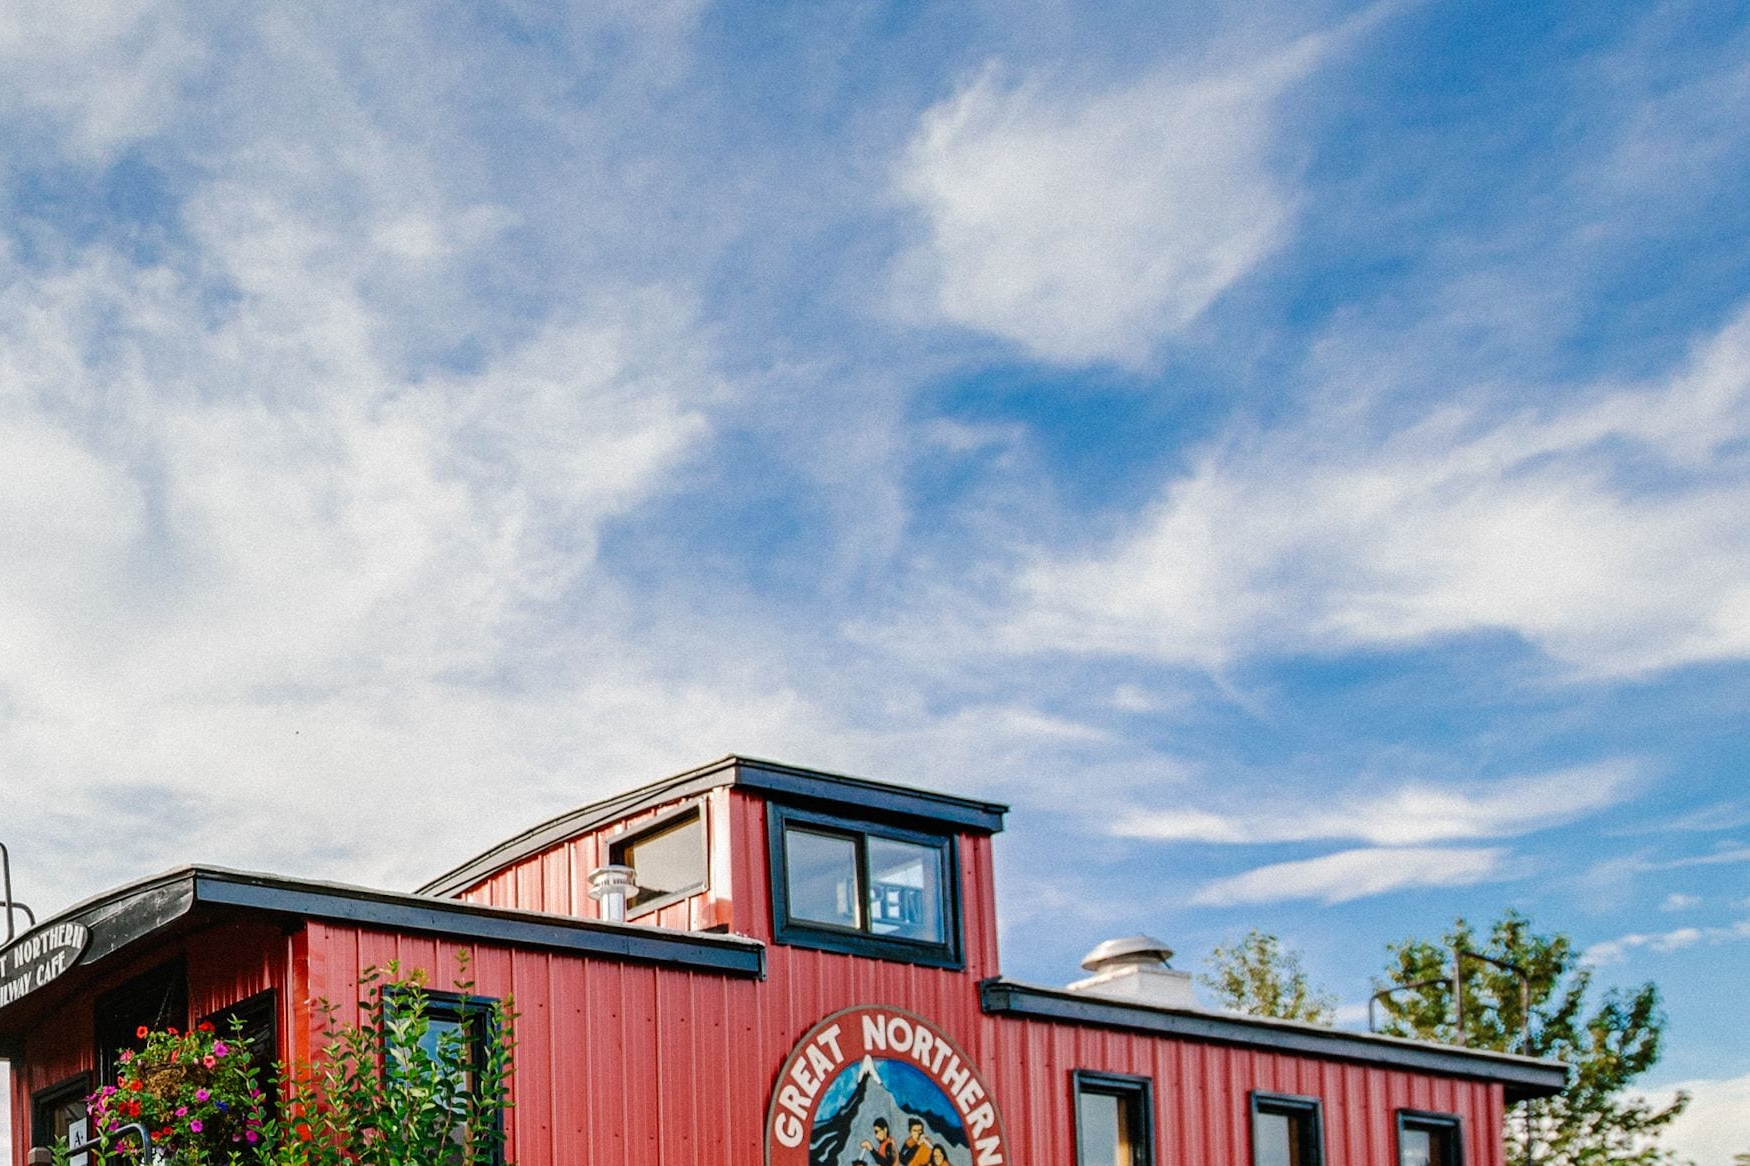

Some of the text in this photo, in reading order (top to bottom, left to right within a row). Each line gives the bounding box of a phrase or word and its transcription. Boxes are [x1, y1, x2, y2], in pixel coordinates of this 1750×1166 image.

[13, 923, 85, 969] NORTHERN
[35, 950, 66, 987] CAFE
[774, 1023, 845, 1148] GREAT
